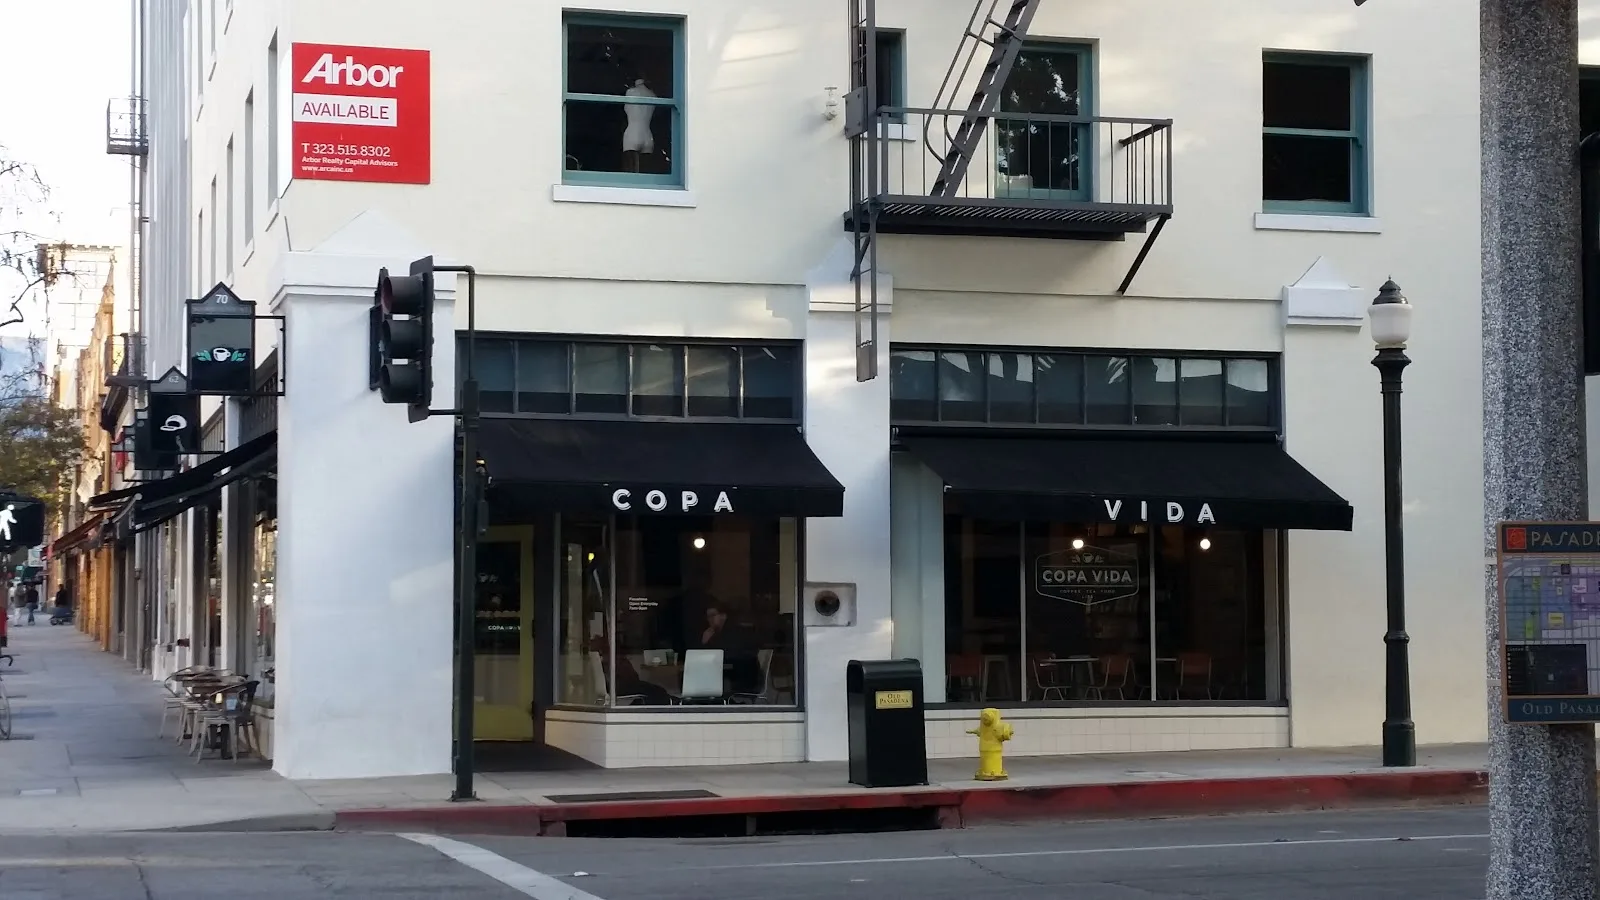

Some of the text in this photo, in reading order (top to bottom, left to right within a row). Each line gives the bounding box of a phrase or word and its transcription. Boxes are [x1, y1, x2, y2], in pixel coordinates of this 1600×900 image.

[301, 52, 404, 88] Arbor
[301, 101, 390, 120] AVAILABLE
[301, 142, 391, 157] T 323.515.8302
[322, 157, 339, 166] Realty
[340, 158, 364, 167] Capital
[364, 159, 399, 167] Advisors
[215, 294, 229, 304] 70
[612, 488, 735, 513] COPA
[1103, 499, 1217, 524] VIDA
[1042, 569, 1133, 583] COPA VIDA
